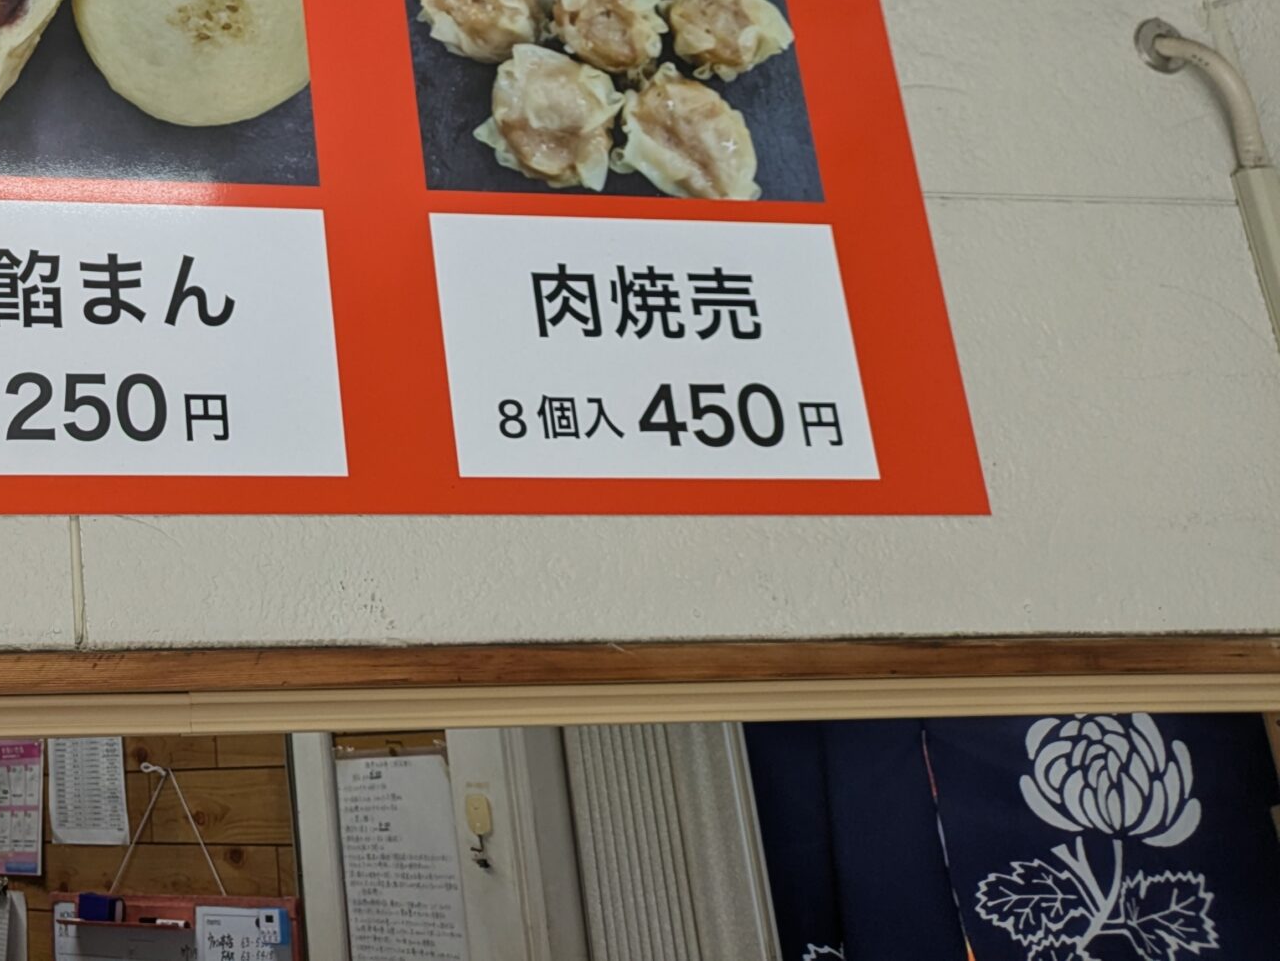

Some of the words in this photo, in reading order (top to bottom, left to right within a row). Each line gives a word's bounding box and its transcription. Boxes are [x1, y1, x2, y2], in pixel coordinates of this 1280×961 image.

[530, 262, 762, 341] 肉焼売
[5, 372, 230, 442] 250円
[638, 382, 845, 448] 450円
